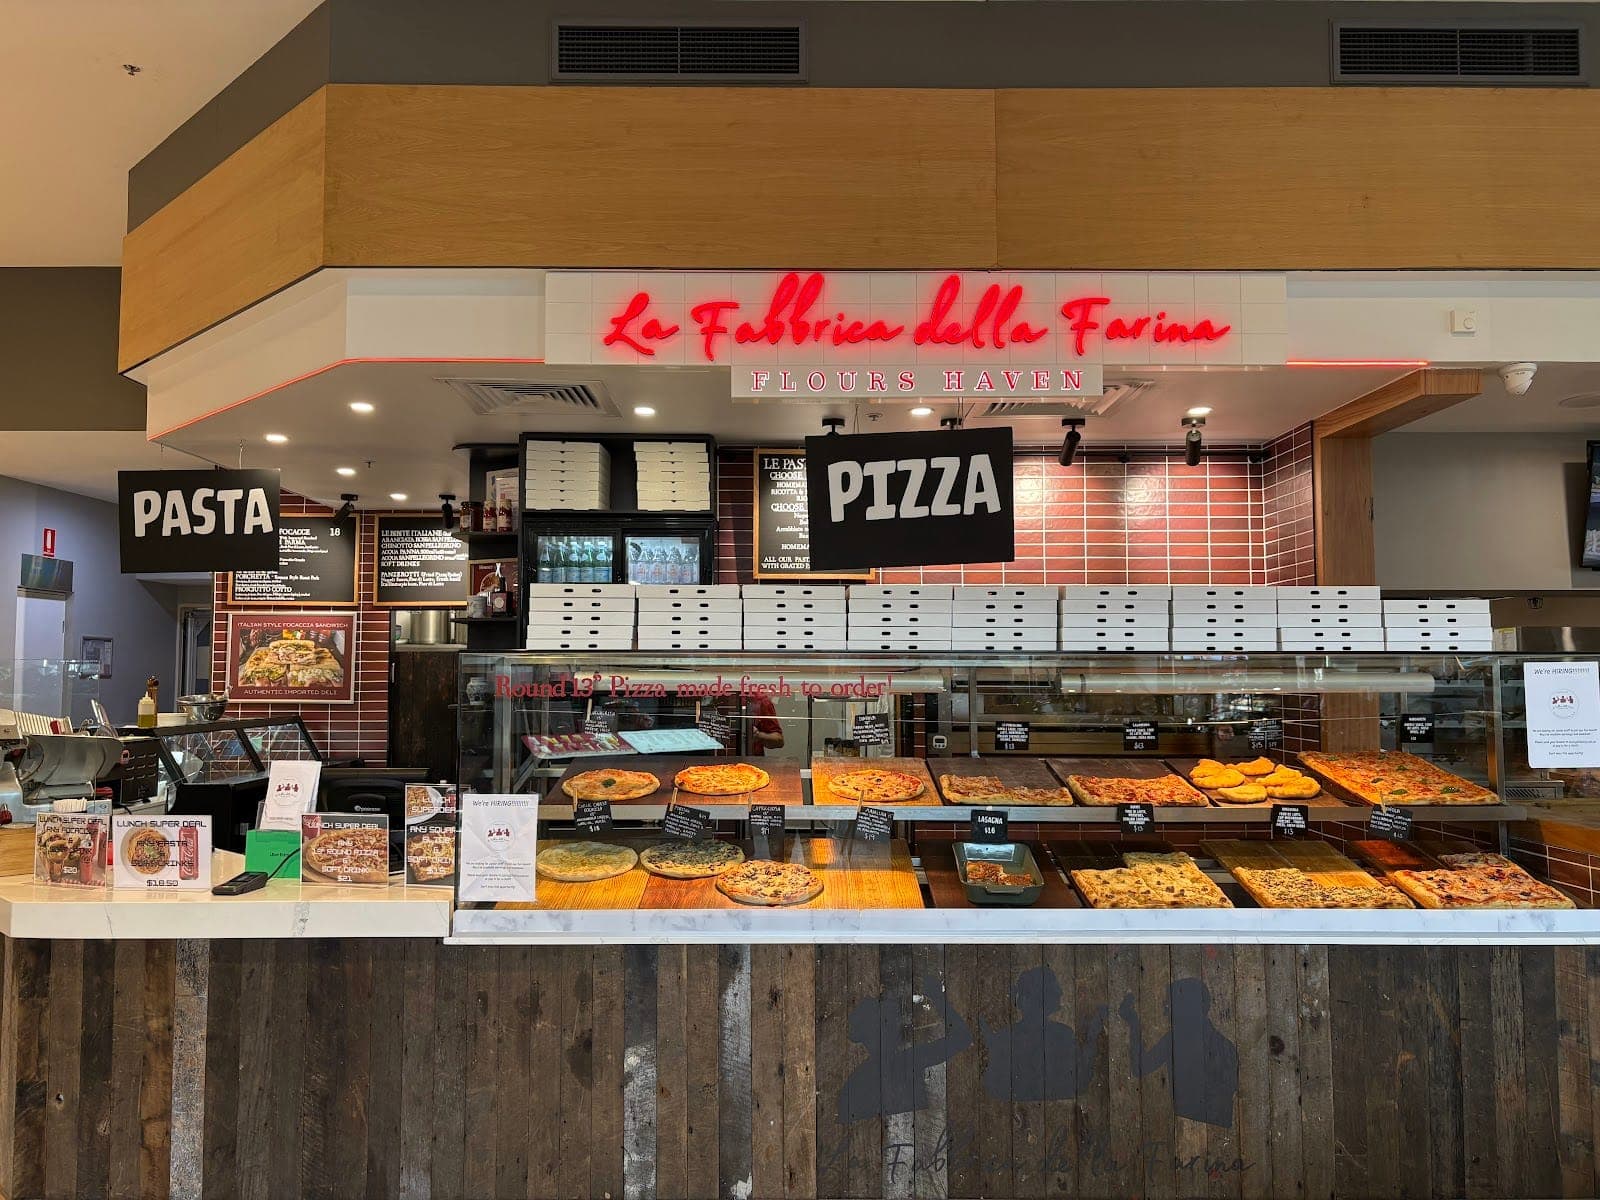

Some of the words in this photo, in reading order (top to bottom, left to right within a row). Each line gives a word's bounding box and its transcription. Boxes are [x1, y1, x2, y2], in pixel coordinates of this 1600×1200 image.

[604, 291, 680, 357] La
[691, 271, 904, 361] Fabbrica
[914, 274, 1049, 348] della
[1060, 297, 1231, 357] Farina
[751, 370, 916, 393] FLOURS
[943, 369, 1083, 392] HAVEN
[764, 458, 780, 470] LE
[782, 458, 806, 470] PAS
[827, 453, 1001, 522] PIZZA
[133, 488, 273, 537] PASTA
[494, 674, 565, 698] Round
[608, 675, 667, 698] Pizza
[677, 674, 733, 698] made
[739, 674, 791, 698] fresh
[801, 678, 822, 698] to
[831, 674, 892, 698] order!
[977, 815, 1003, 825] LASAGNA
[431, 856, 452, 864] DRIN
